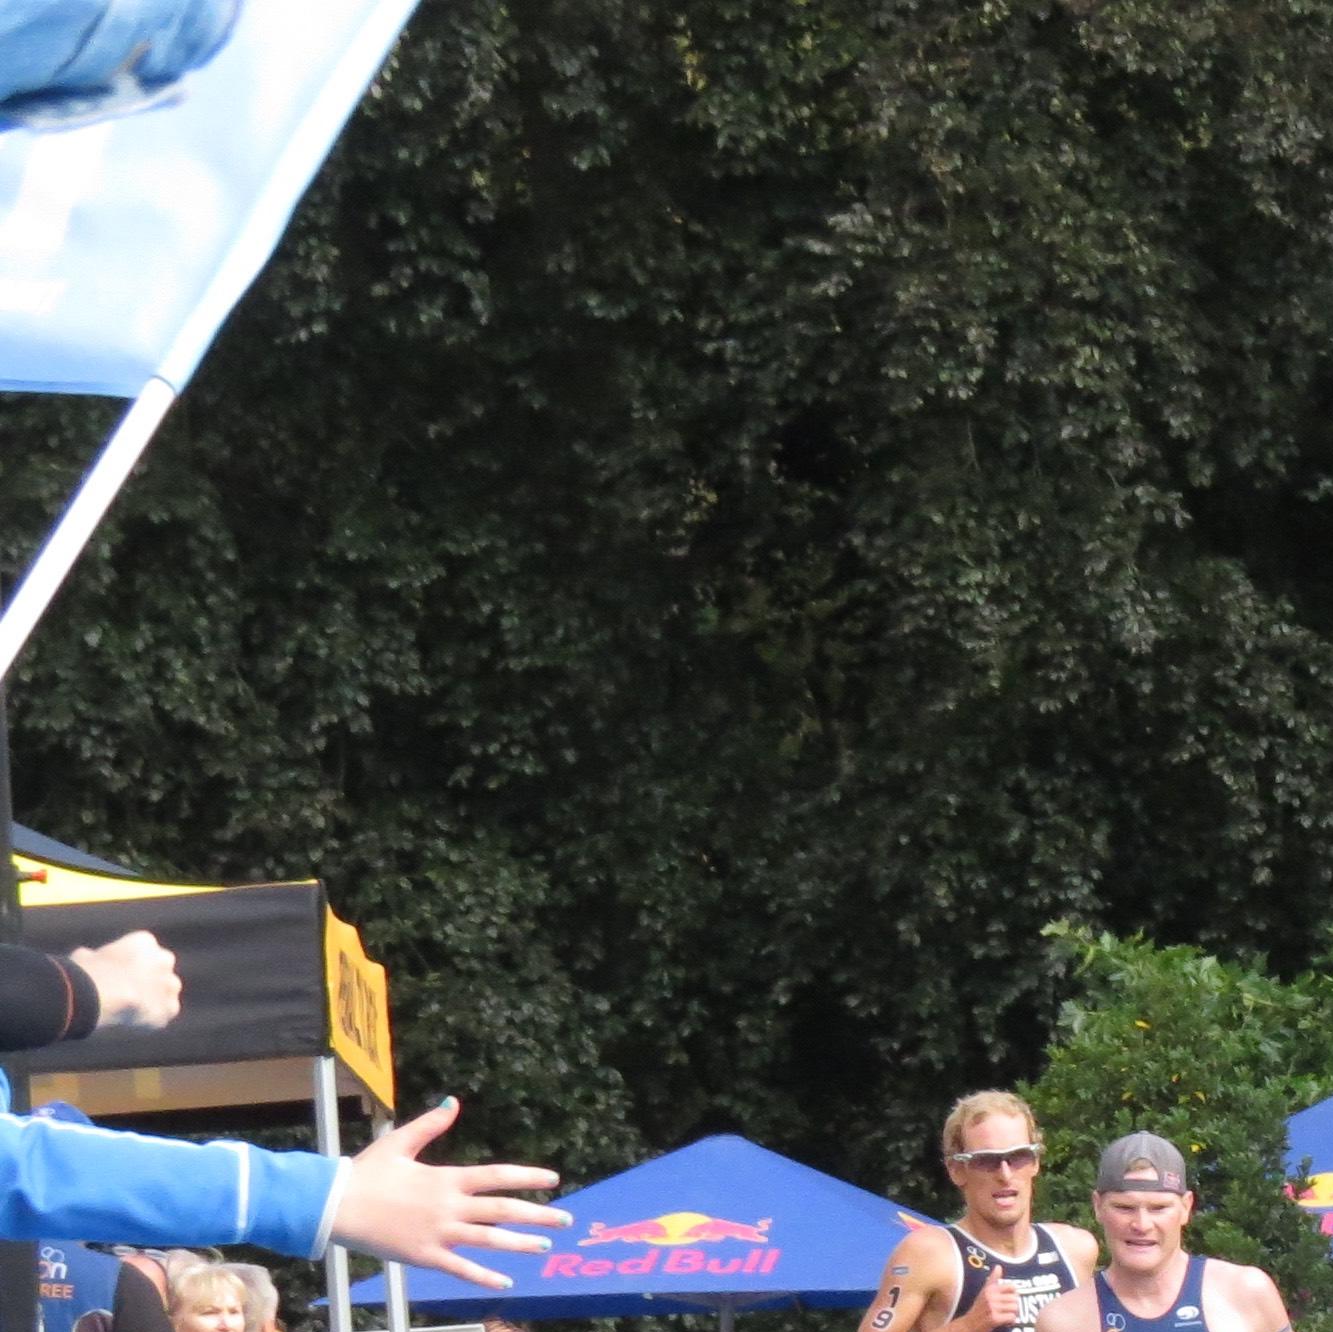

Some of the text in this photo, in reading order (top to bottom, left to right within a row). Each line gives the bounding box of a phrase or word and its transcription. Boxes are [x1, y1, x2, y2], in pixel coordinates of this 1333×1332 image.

[541, 1249, 781, 1278] Red Bull
[872, 1286, 901, 1329] 19
